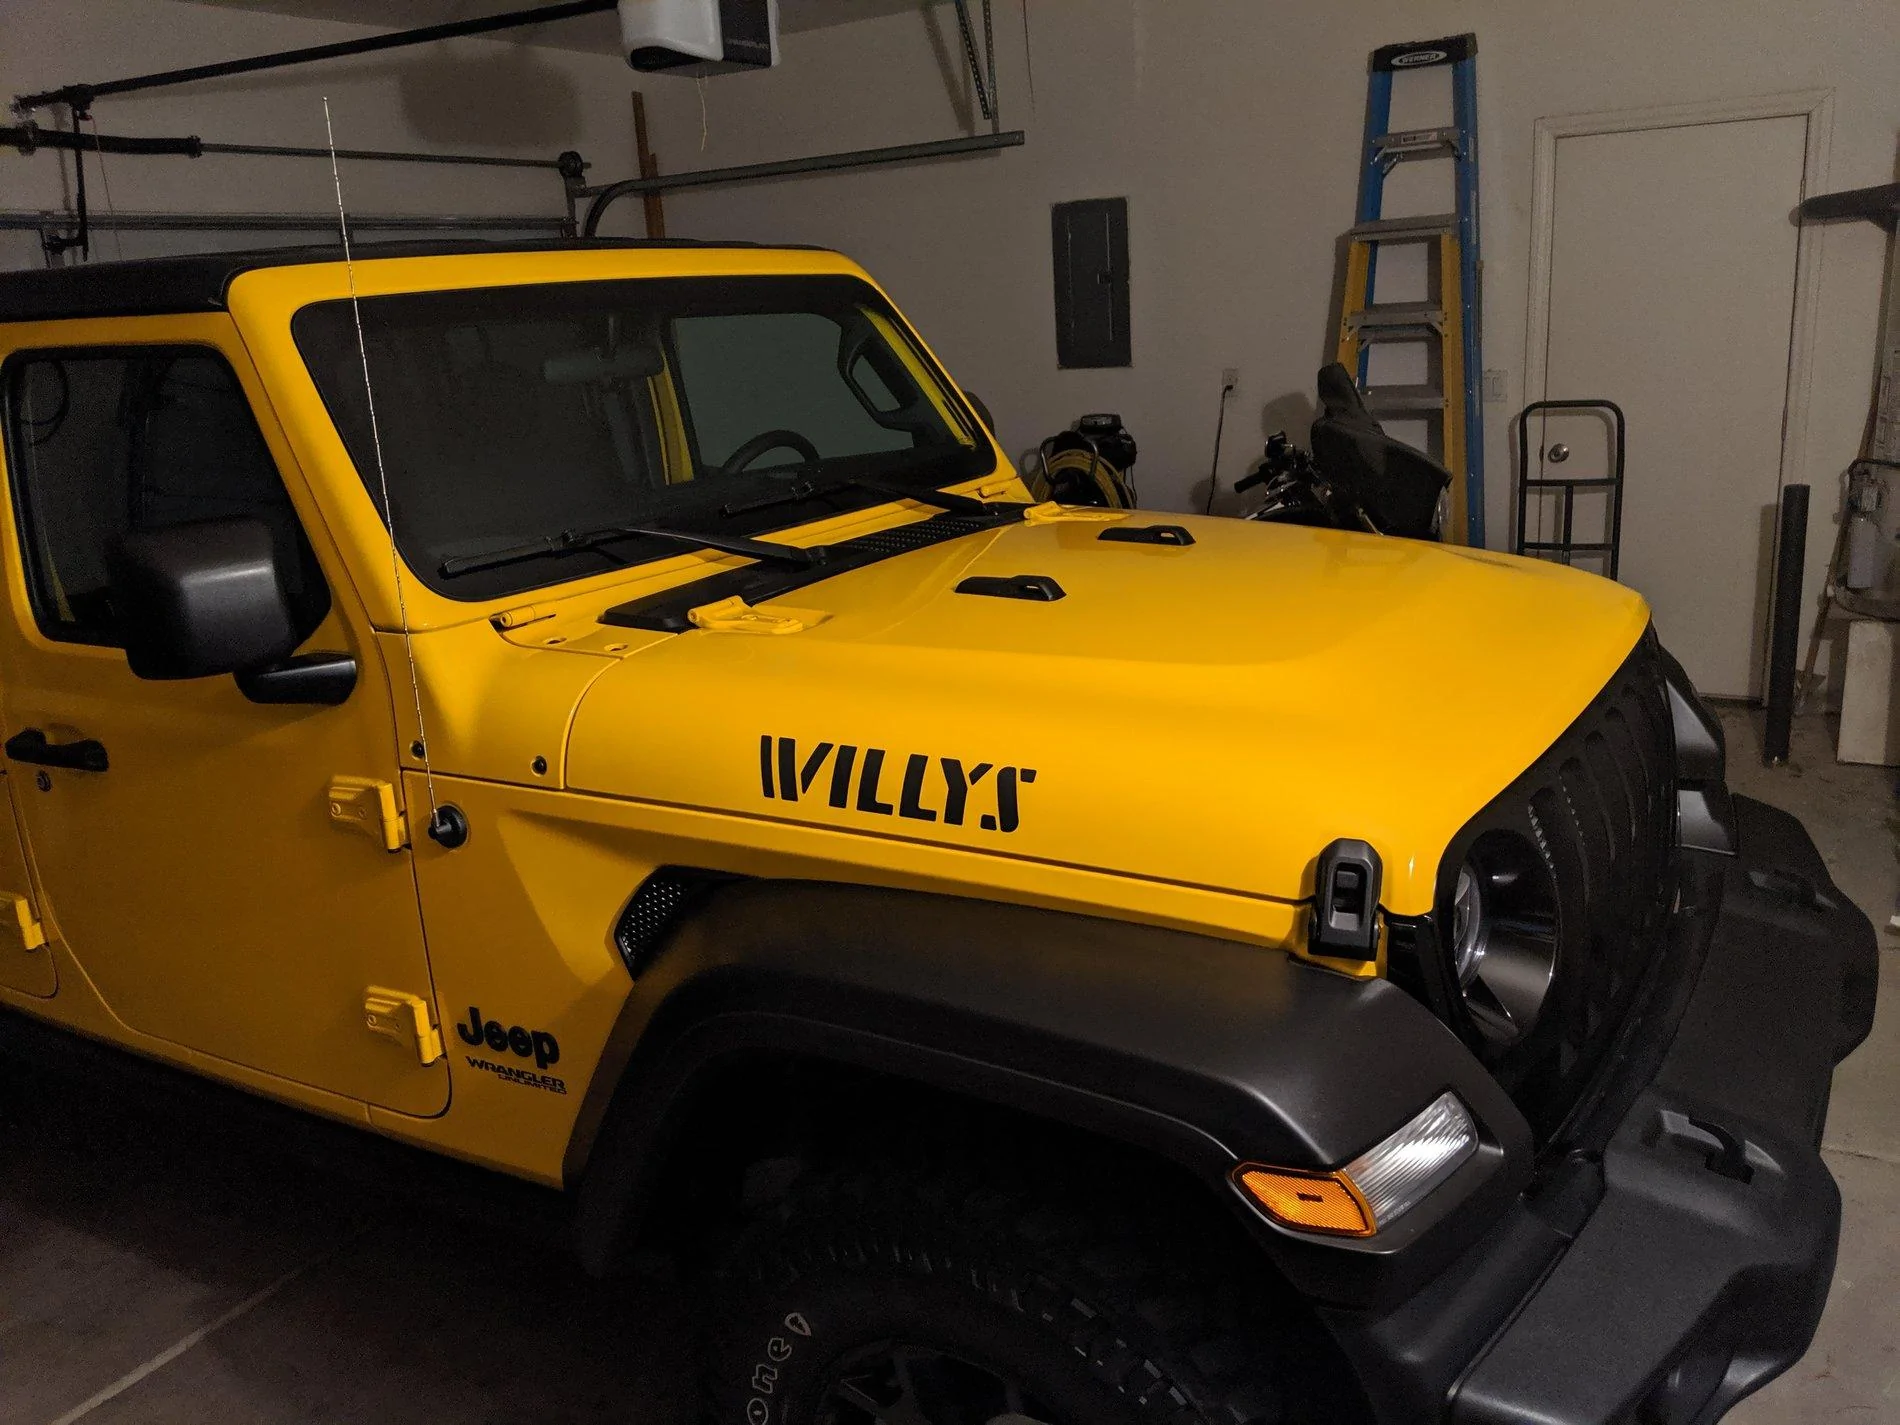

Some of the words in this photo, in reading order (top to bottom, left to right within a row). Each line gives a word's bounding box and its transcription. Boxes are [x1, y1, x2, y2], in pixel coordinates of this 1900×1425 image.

[760, 735, 1037, 832] WILLYS
[457, 1006, 560, 1069] Jeep
[465, 1055, 565, 1090] WRANGLER
[498, 1073, 567, 1095] UNLIMITED
